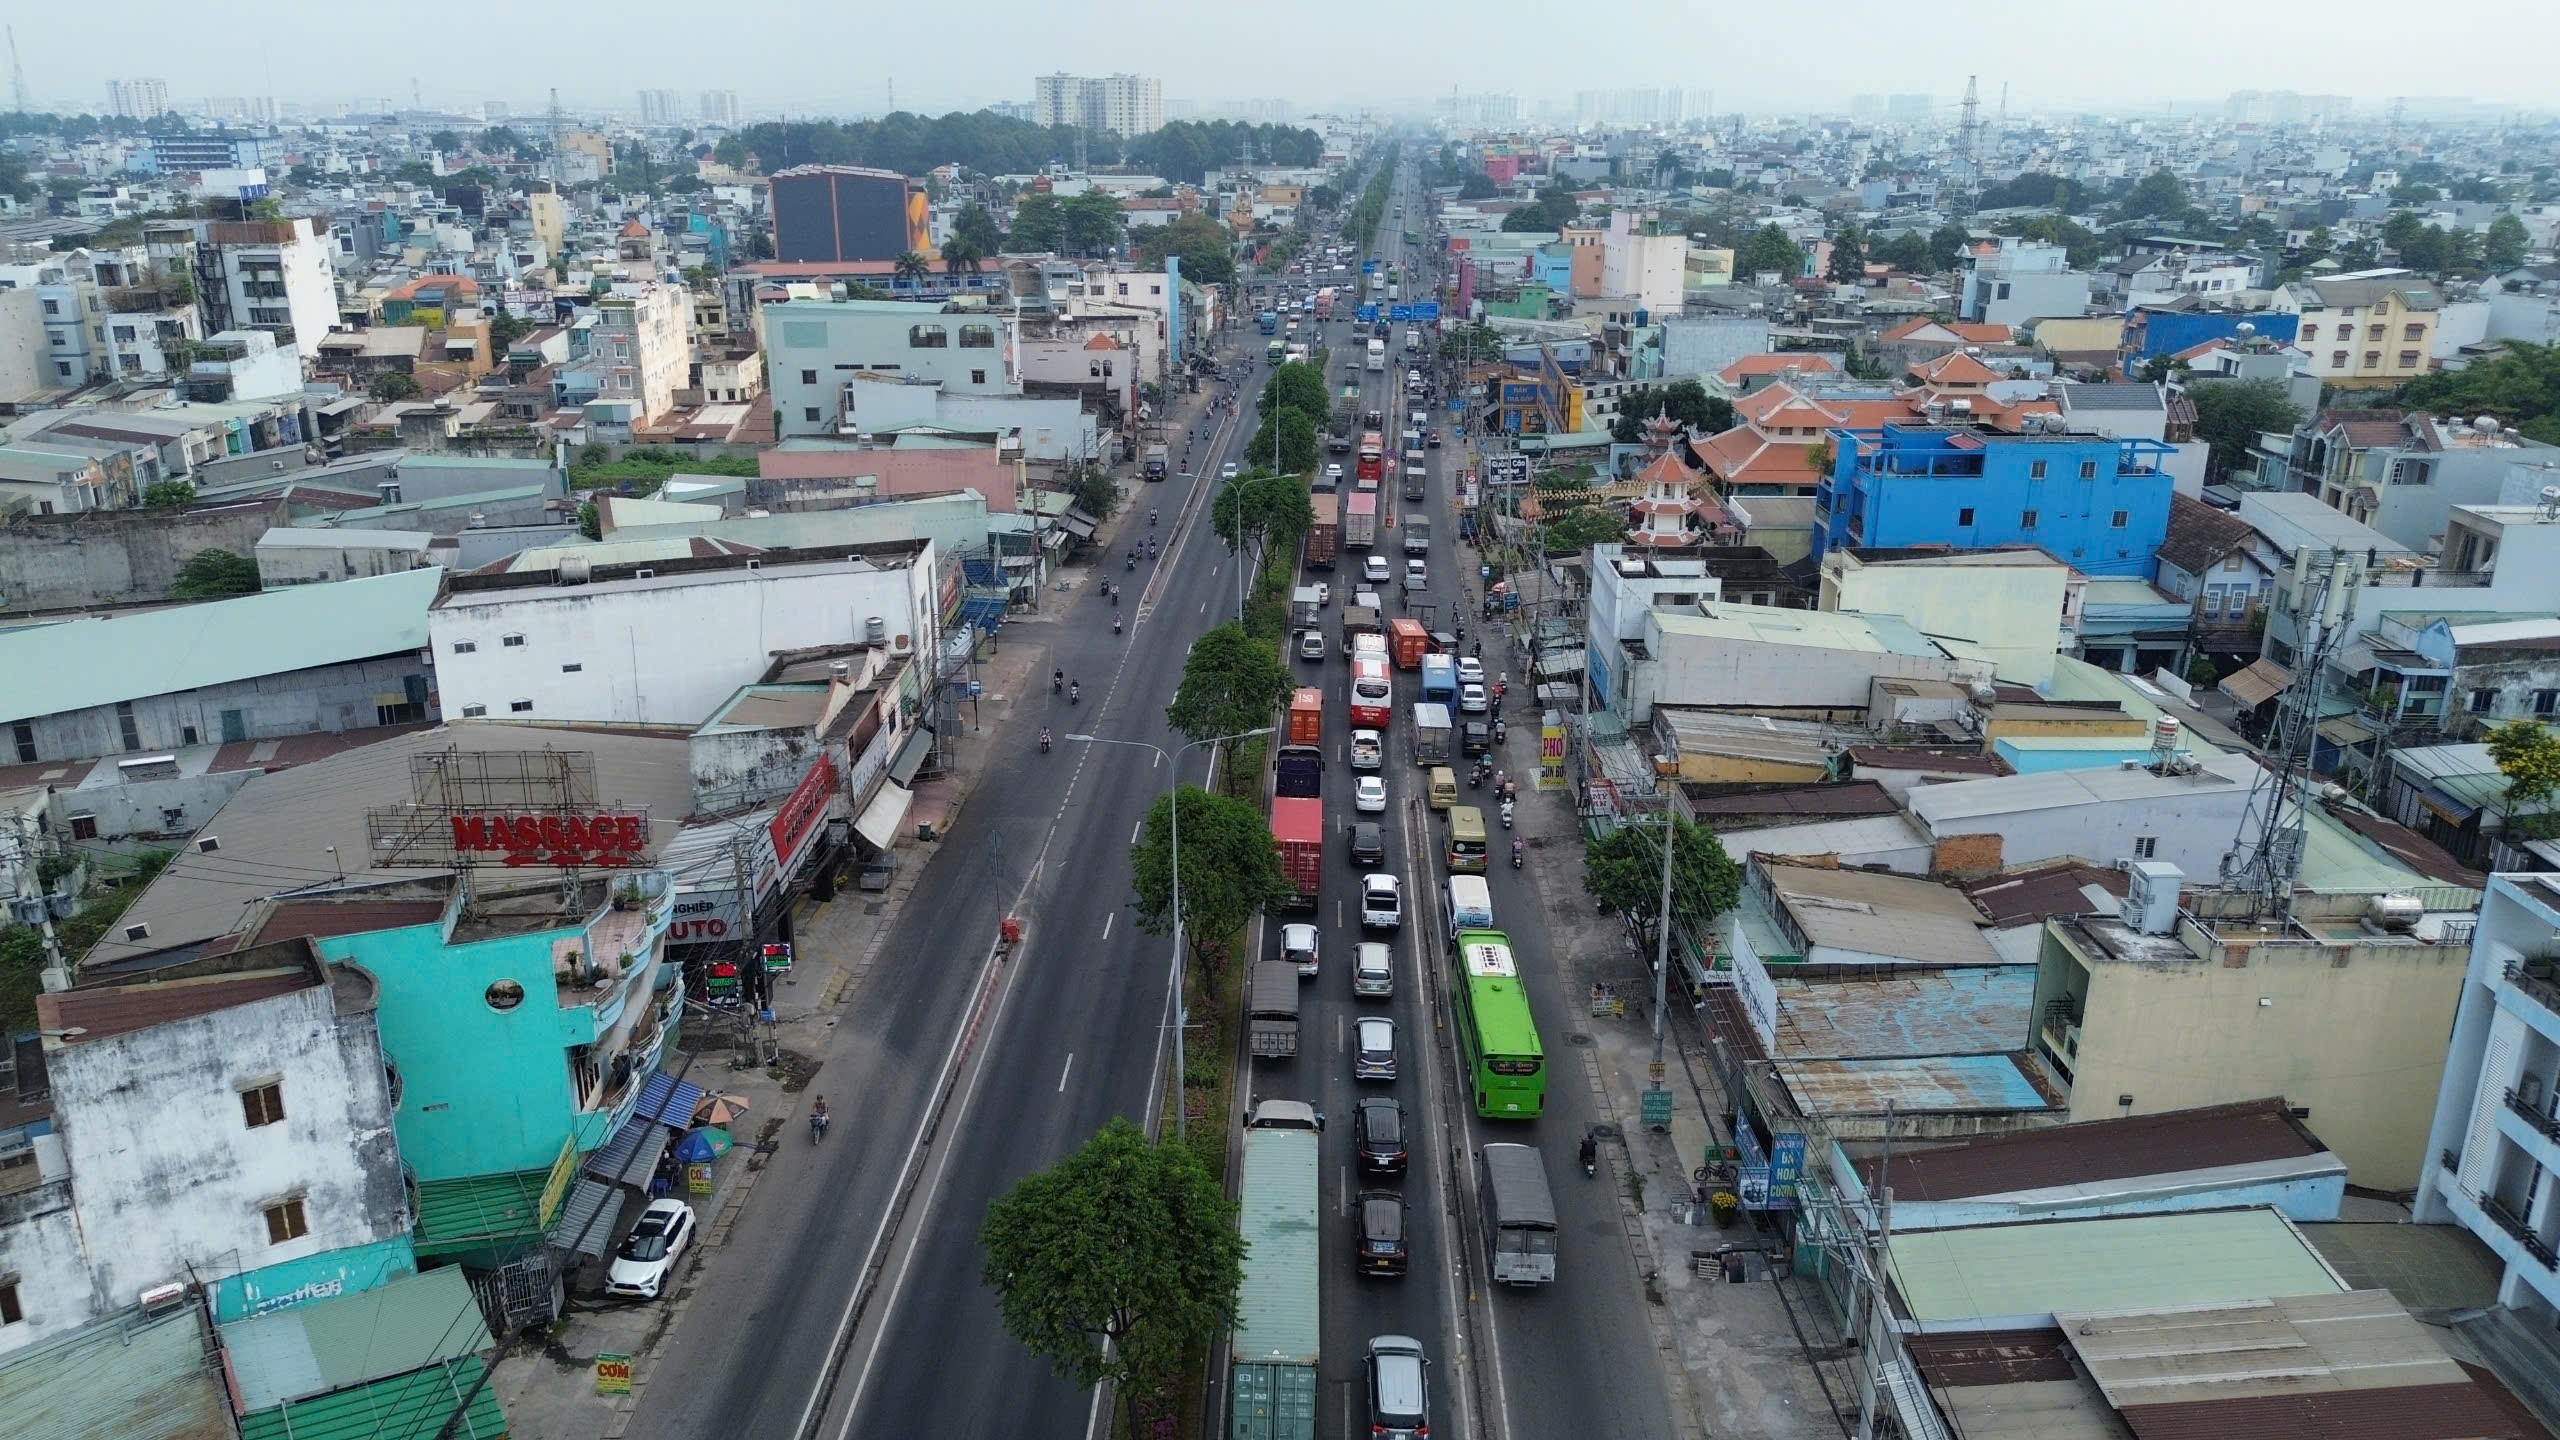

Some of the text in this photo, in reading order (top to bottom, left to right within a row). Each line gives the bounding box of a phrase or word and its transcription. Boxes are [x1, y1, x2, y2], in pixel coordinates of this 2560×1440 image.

[451, 814, 645, 852] MASSAGE
[666, 919, 727, 940] UTO
[1776, 1168, 1796, 1181] HOA
